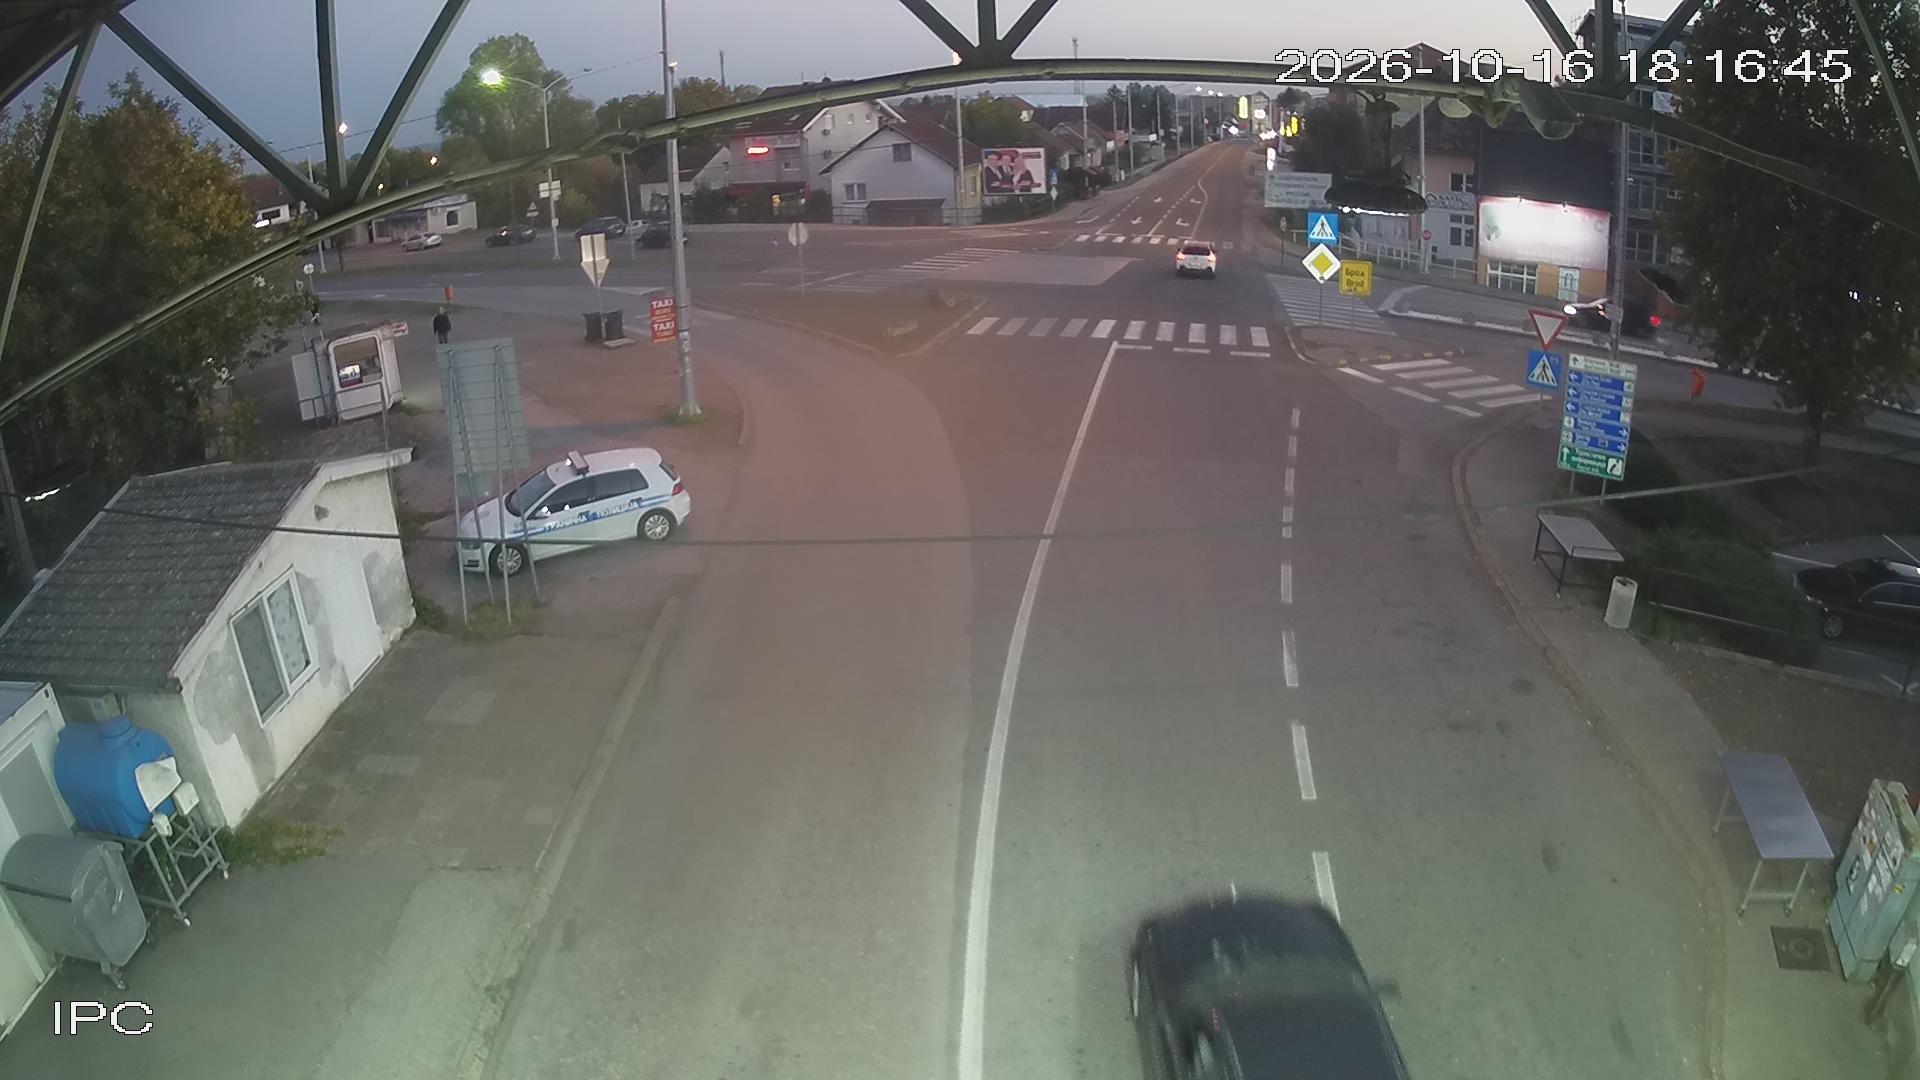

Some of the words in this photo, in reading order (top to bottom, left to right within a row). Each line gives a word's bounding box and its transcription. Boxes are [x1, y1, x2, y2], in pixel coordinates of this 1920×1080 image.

[1346, 279, 1364, 287] Brod
[651, 299, 673, 308] TAXI
[653, 321, 675, 331] TAXI
